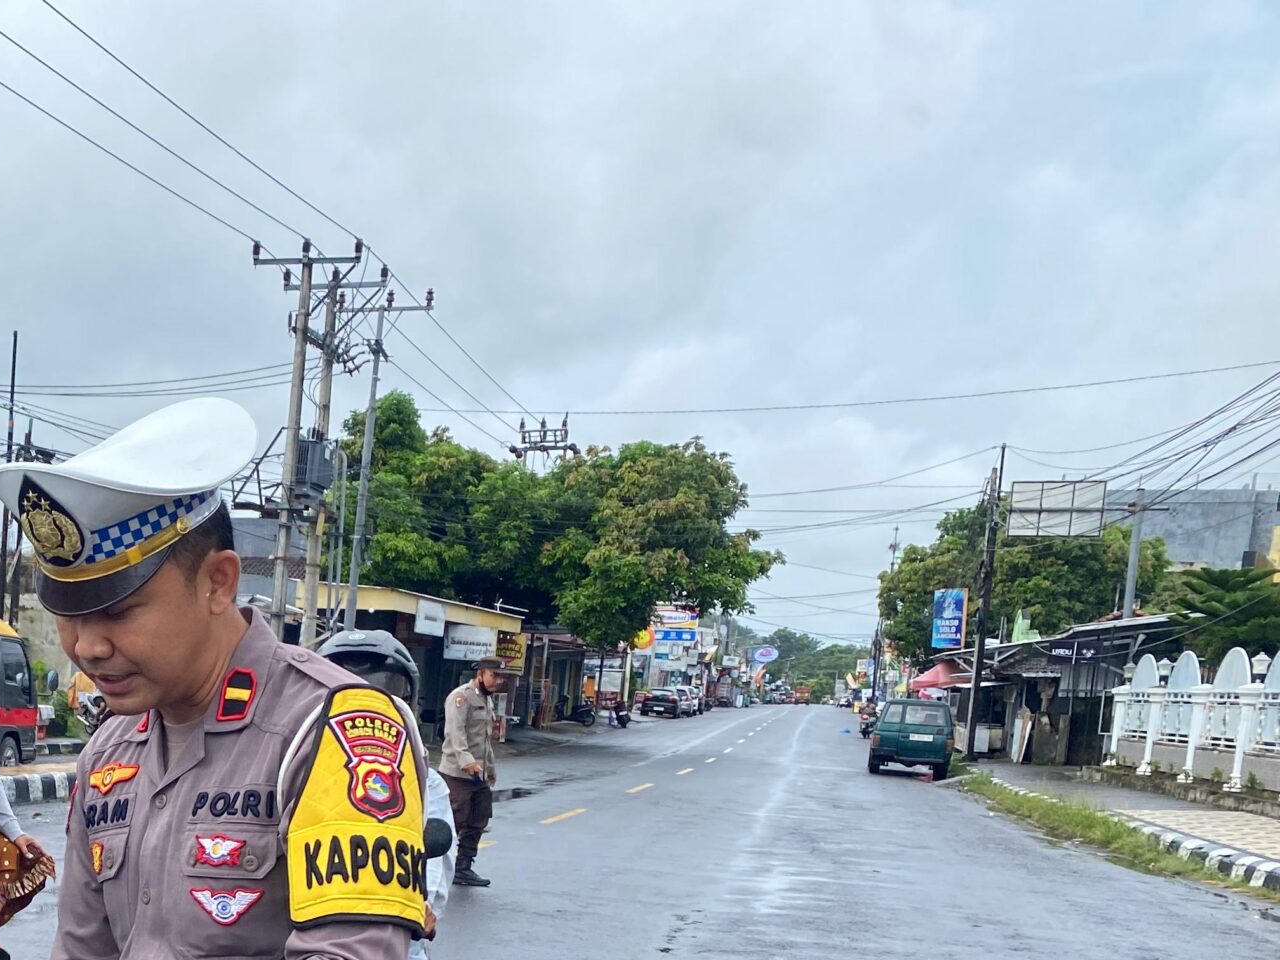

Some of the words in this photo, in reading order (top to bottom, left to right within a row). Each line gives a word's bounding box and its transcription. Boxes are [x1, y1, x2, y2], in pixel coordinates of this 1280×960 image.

[343, 717, 398, 736] POLRES
[83, 798, 129, 829] RAM
[191, 789, 274, 818] POLRI
